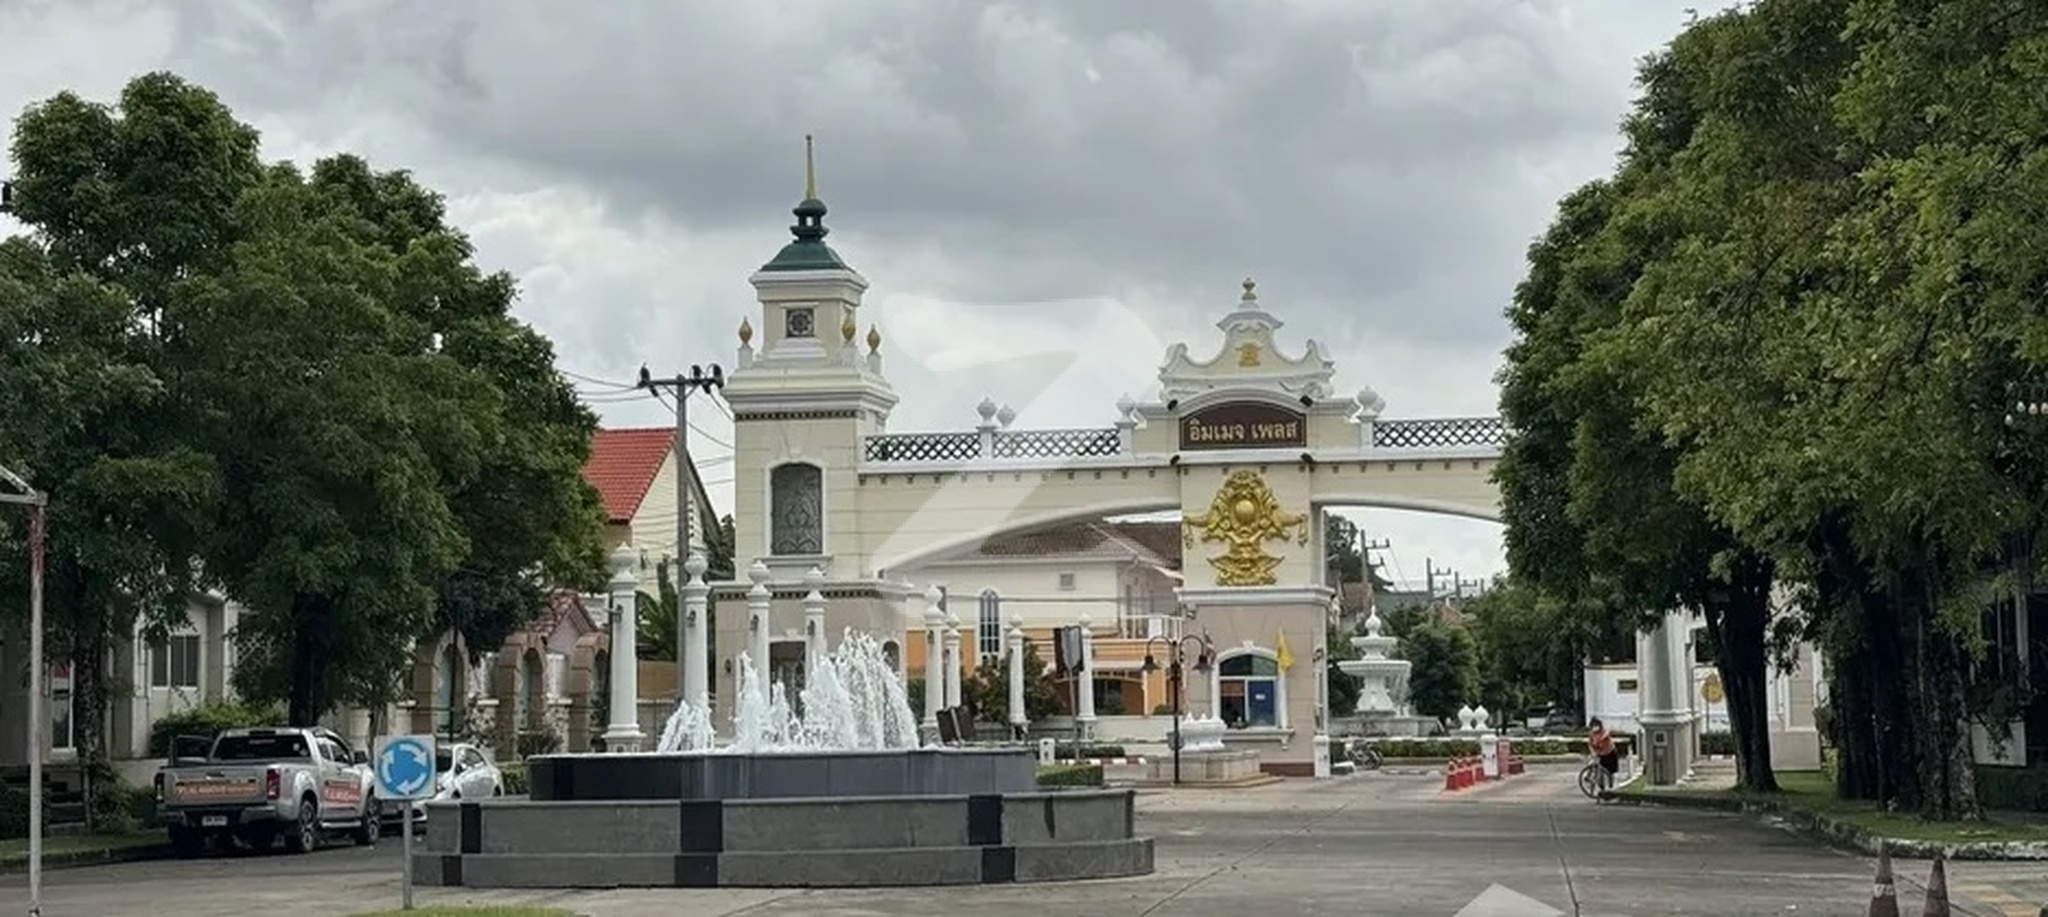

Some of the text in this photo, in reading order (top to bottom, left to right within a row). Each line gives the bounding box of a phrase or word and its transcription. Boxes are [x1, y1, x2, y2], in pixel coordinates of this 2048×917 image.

[1189, 418, 1298, 441] อิมเมจ เพลส
